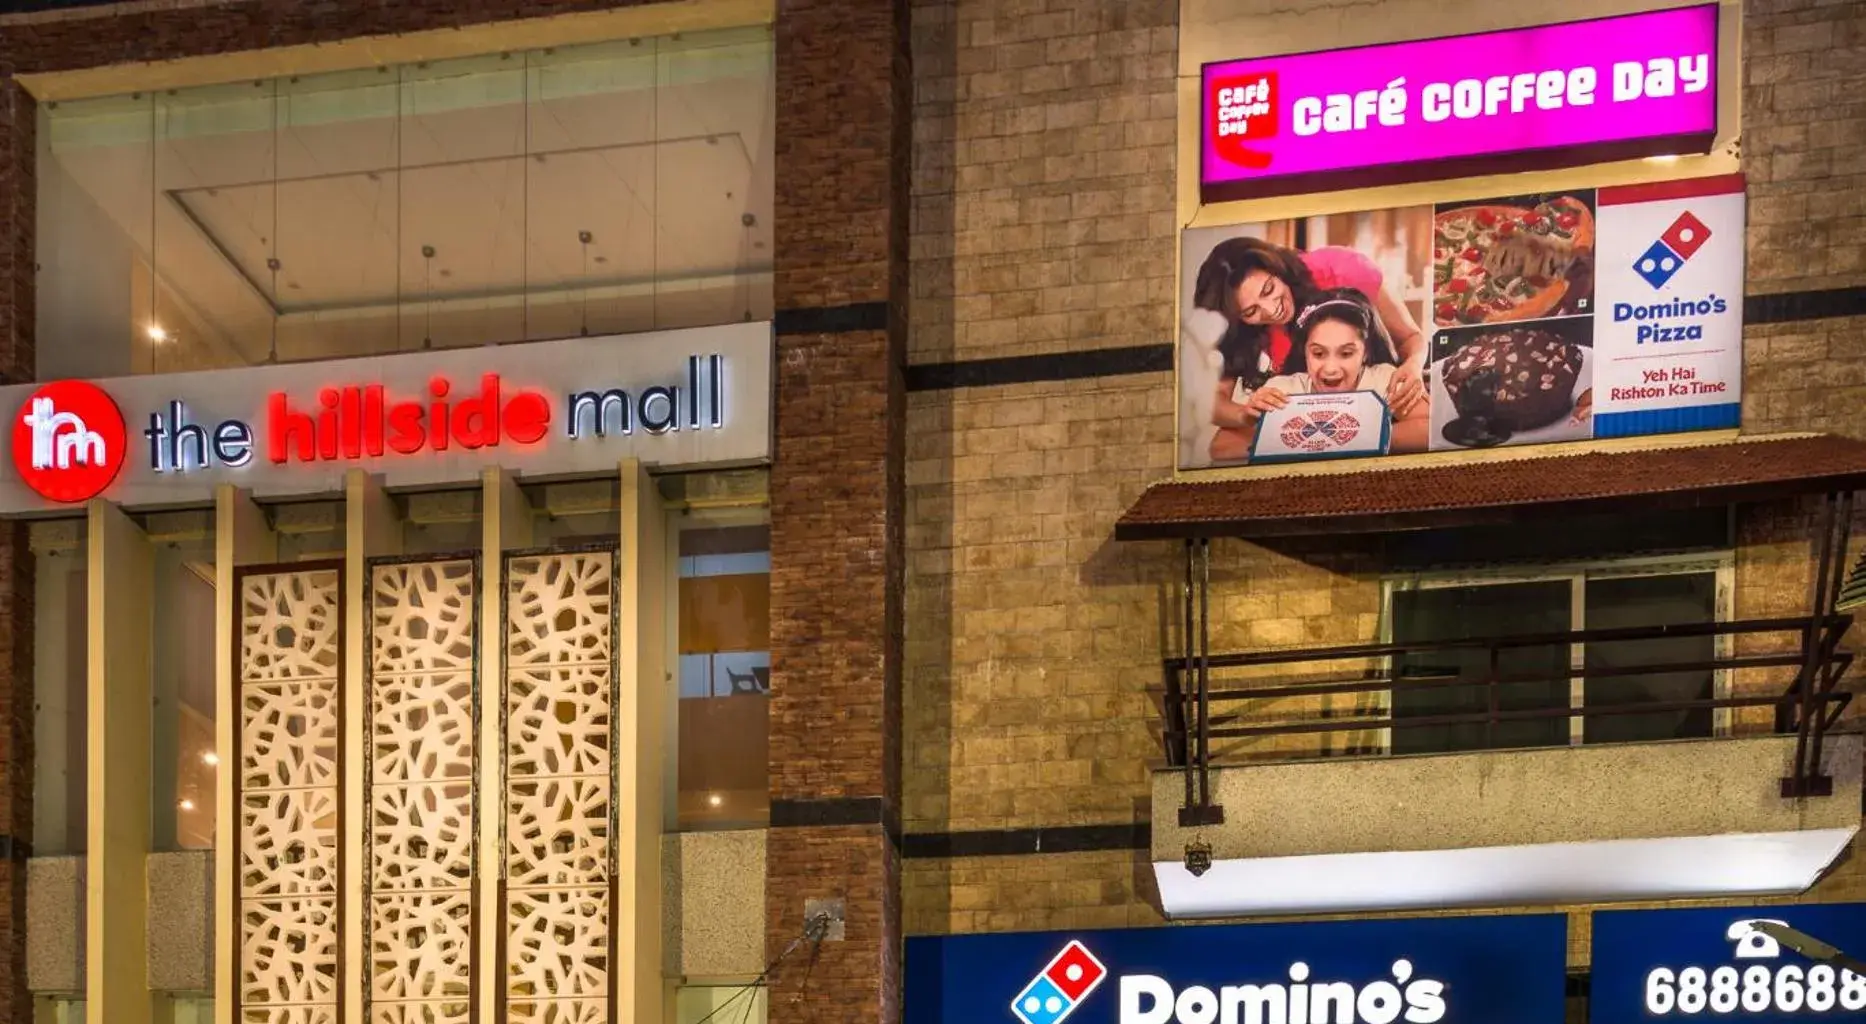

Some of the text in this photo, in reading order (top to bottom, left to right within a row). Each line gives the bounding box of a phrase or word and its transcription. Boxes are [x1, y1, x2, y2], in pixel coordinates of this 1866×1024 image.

[1614, 293, 1727, 322] Domino's
[1637, 323, 1703, 344] Pizza
[1642, 367, 1696, 384] Yeh Hai
[1610, 381, 1726, 401] Rishton Ka Time
[145, 352, 723, 473] the hillside mall
